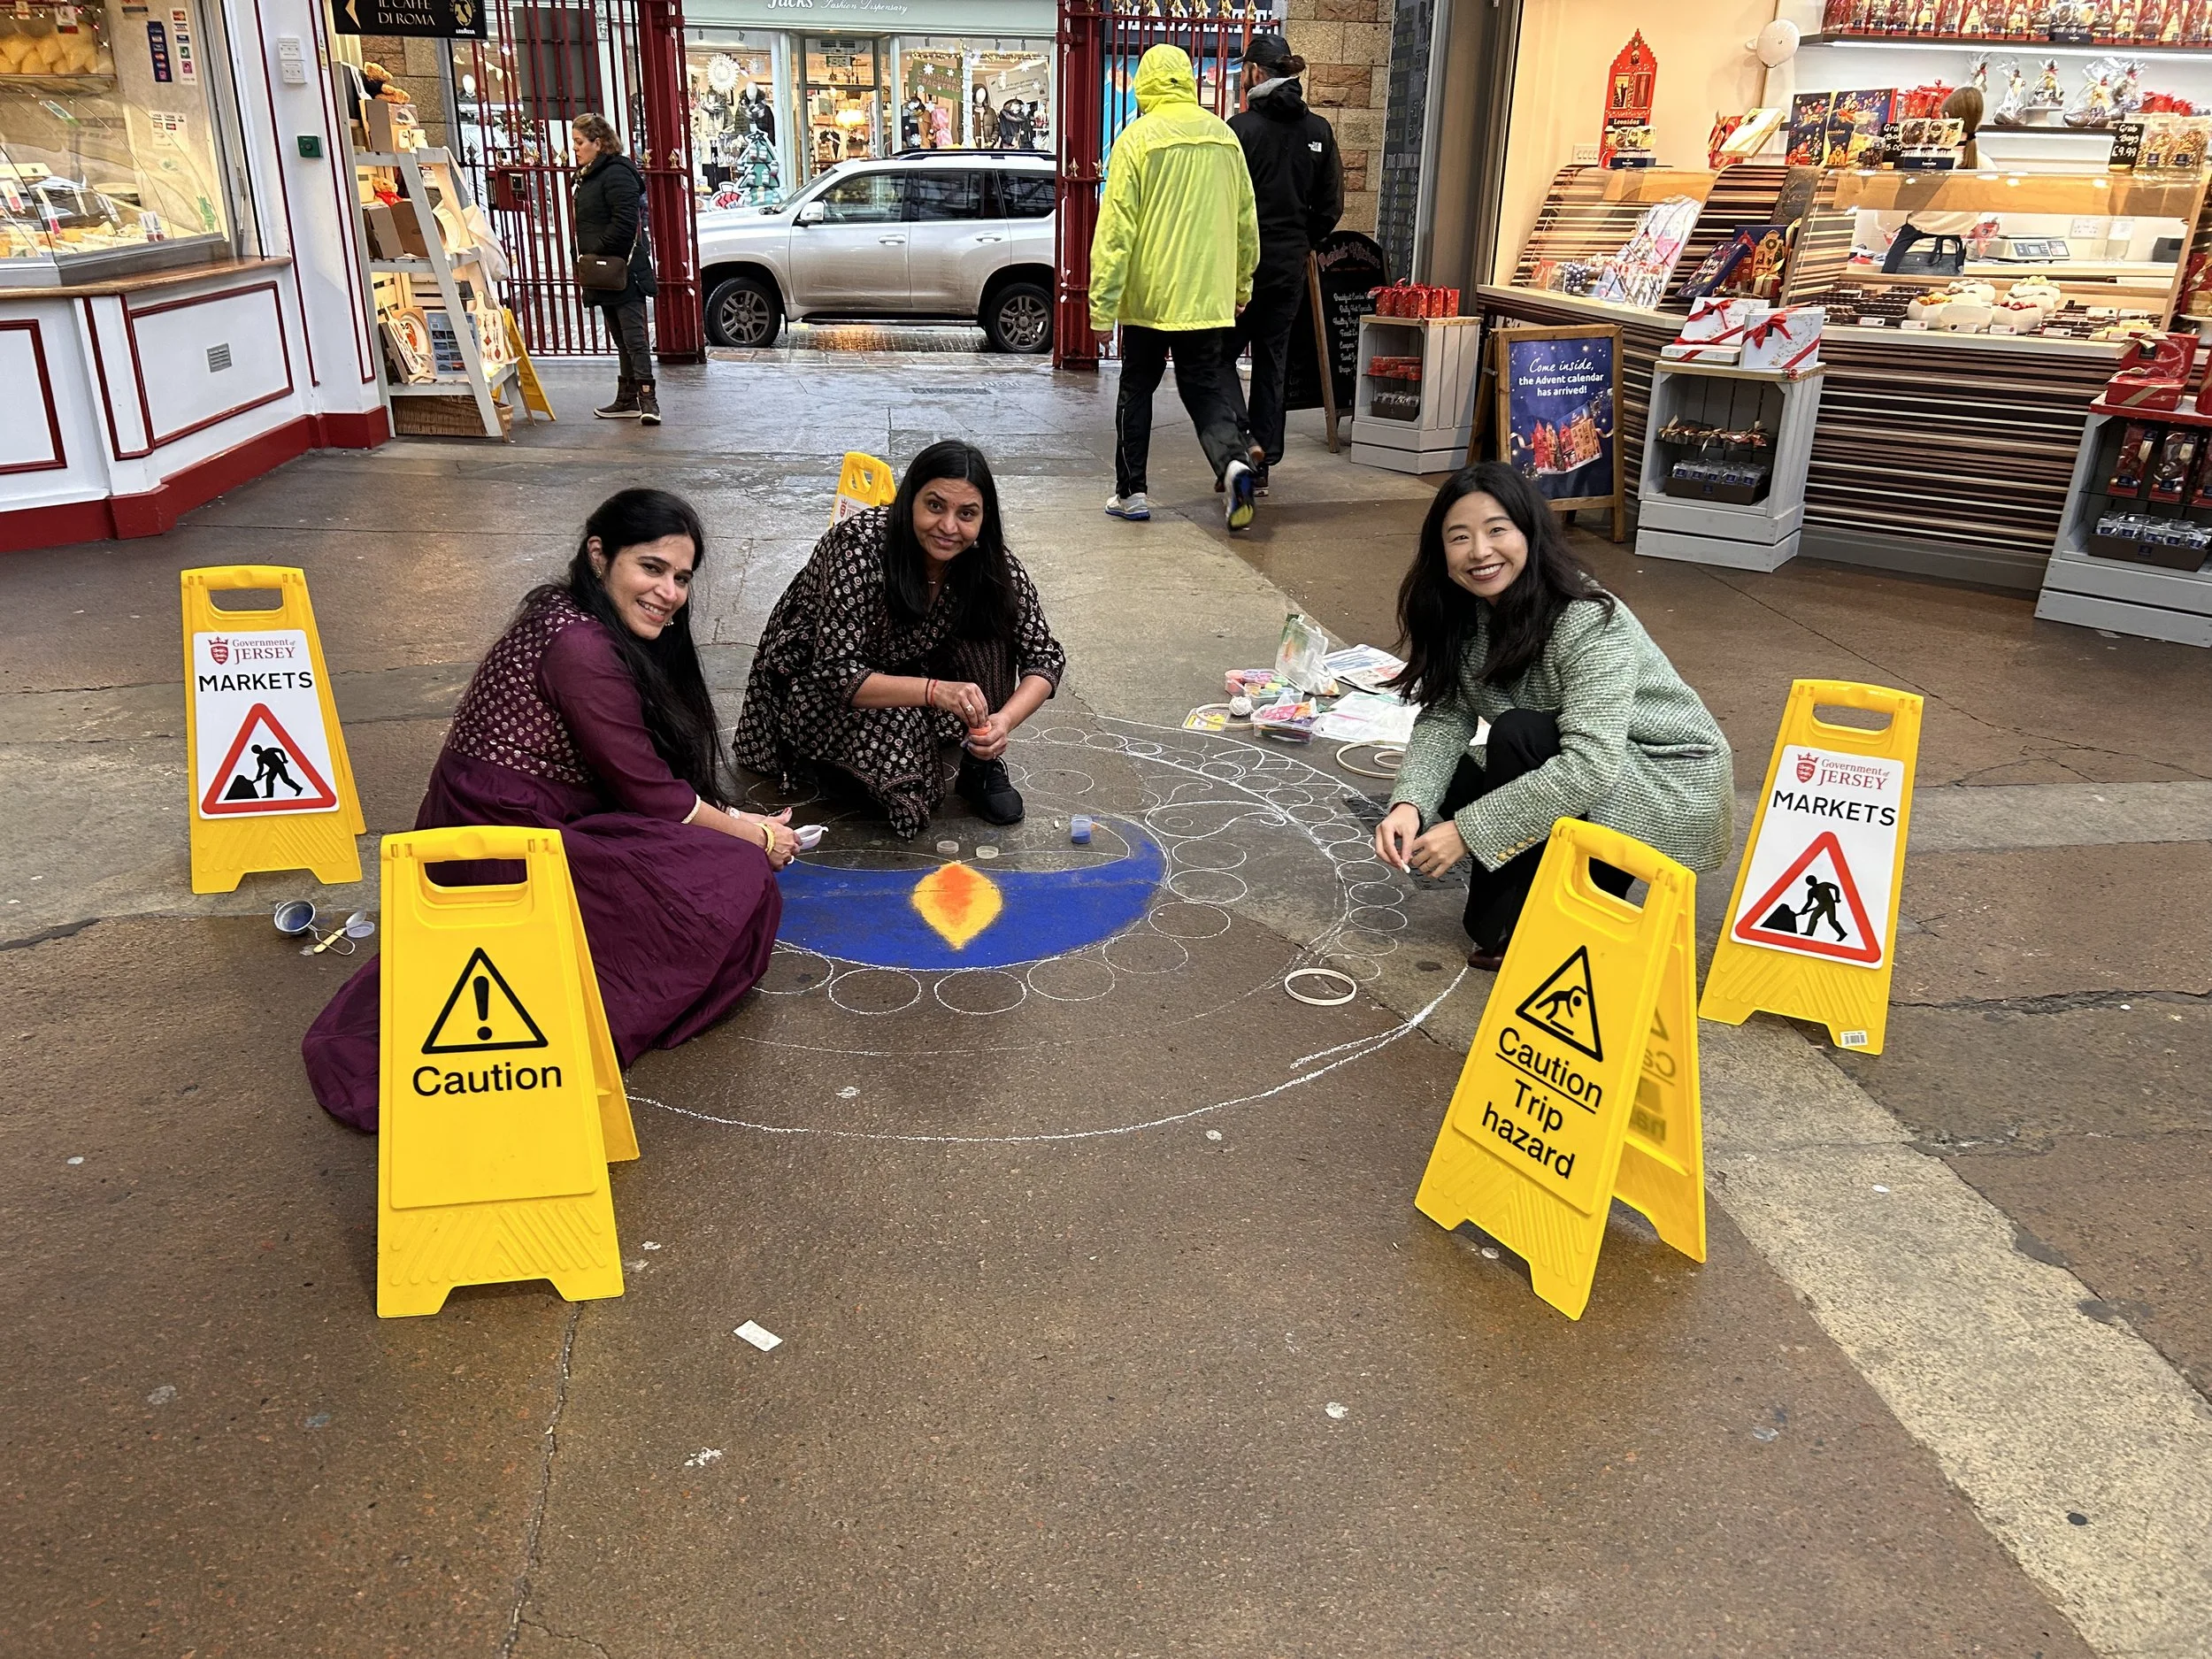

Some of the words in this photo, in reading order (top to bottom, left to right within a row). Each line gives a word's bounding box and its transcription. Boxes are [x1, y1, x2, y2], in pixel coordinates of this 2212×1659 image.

[860, 0, 908, 15] Dispensary
[378, 12, 393, 24] DI
[396, 13, 435, 26] ROMA
[2119, 124, 2139, 133] Grab
[2119, 134, 2139, 145] Bags
[2111, 145, 2137, 157] £9.99
[1530, 357, 1555, 373] Come
[1559, 357, 1594, 372] inside,
[1518, 376, 1533, 385] the
[1535, 375, 1566, 384] Advent
[1567, 373, 1604, 383] calendar
[1537, 388, 1552, 396] has
[1553, 386, 1587, 396] arrived!
[232, 639, 288, 648] Government
[234, 647, 296, 664] JERSEY
[198, 672, 313, 692] MARKETS
[1821, 759, 1882, 776] Government
[1816, 770, 1889, 790] JERSEY
[1772, 789, 1897, 826] MARKETS
[1499, 1027, 1602, 1108] Caution
[412, 1062, 562, 1096] Caution
[1514, 1079, 1563, 1133] Trip
[1481, 1101, 1575, 1179] hazard
